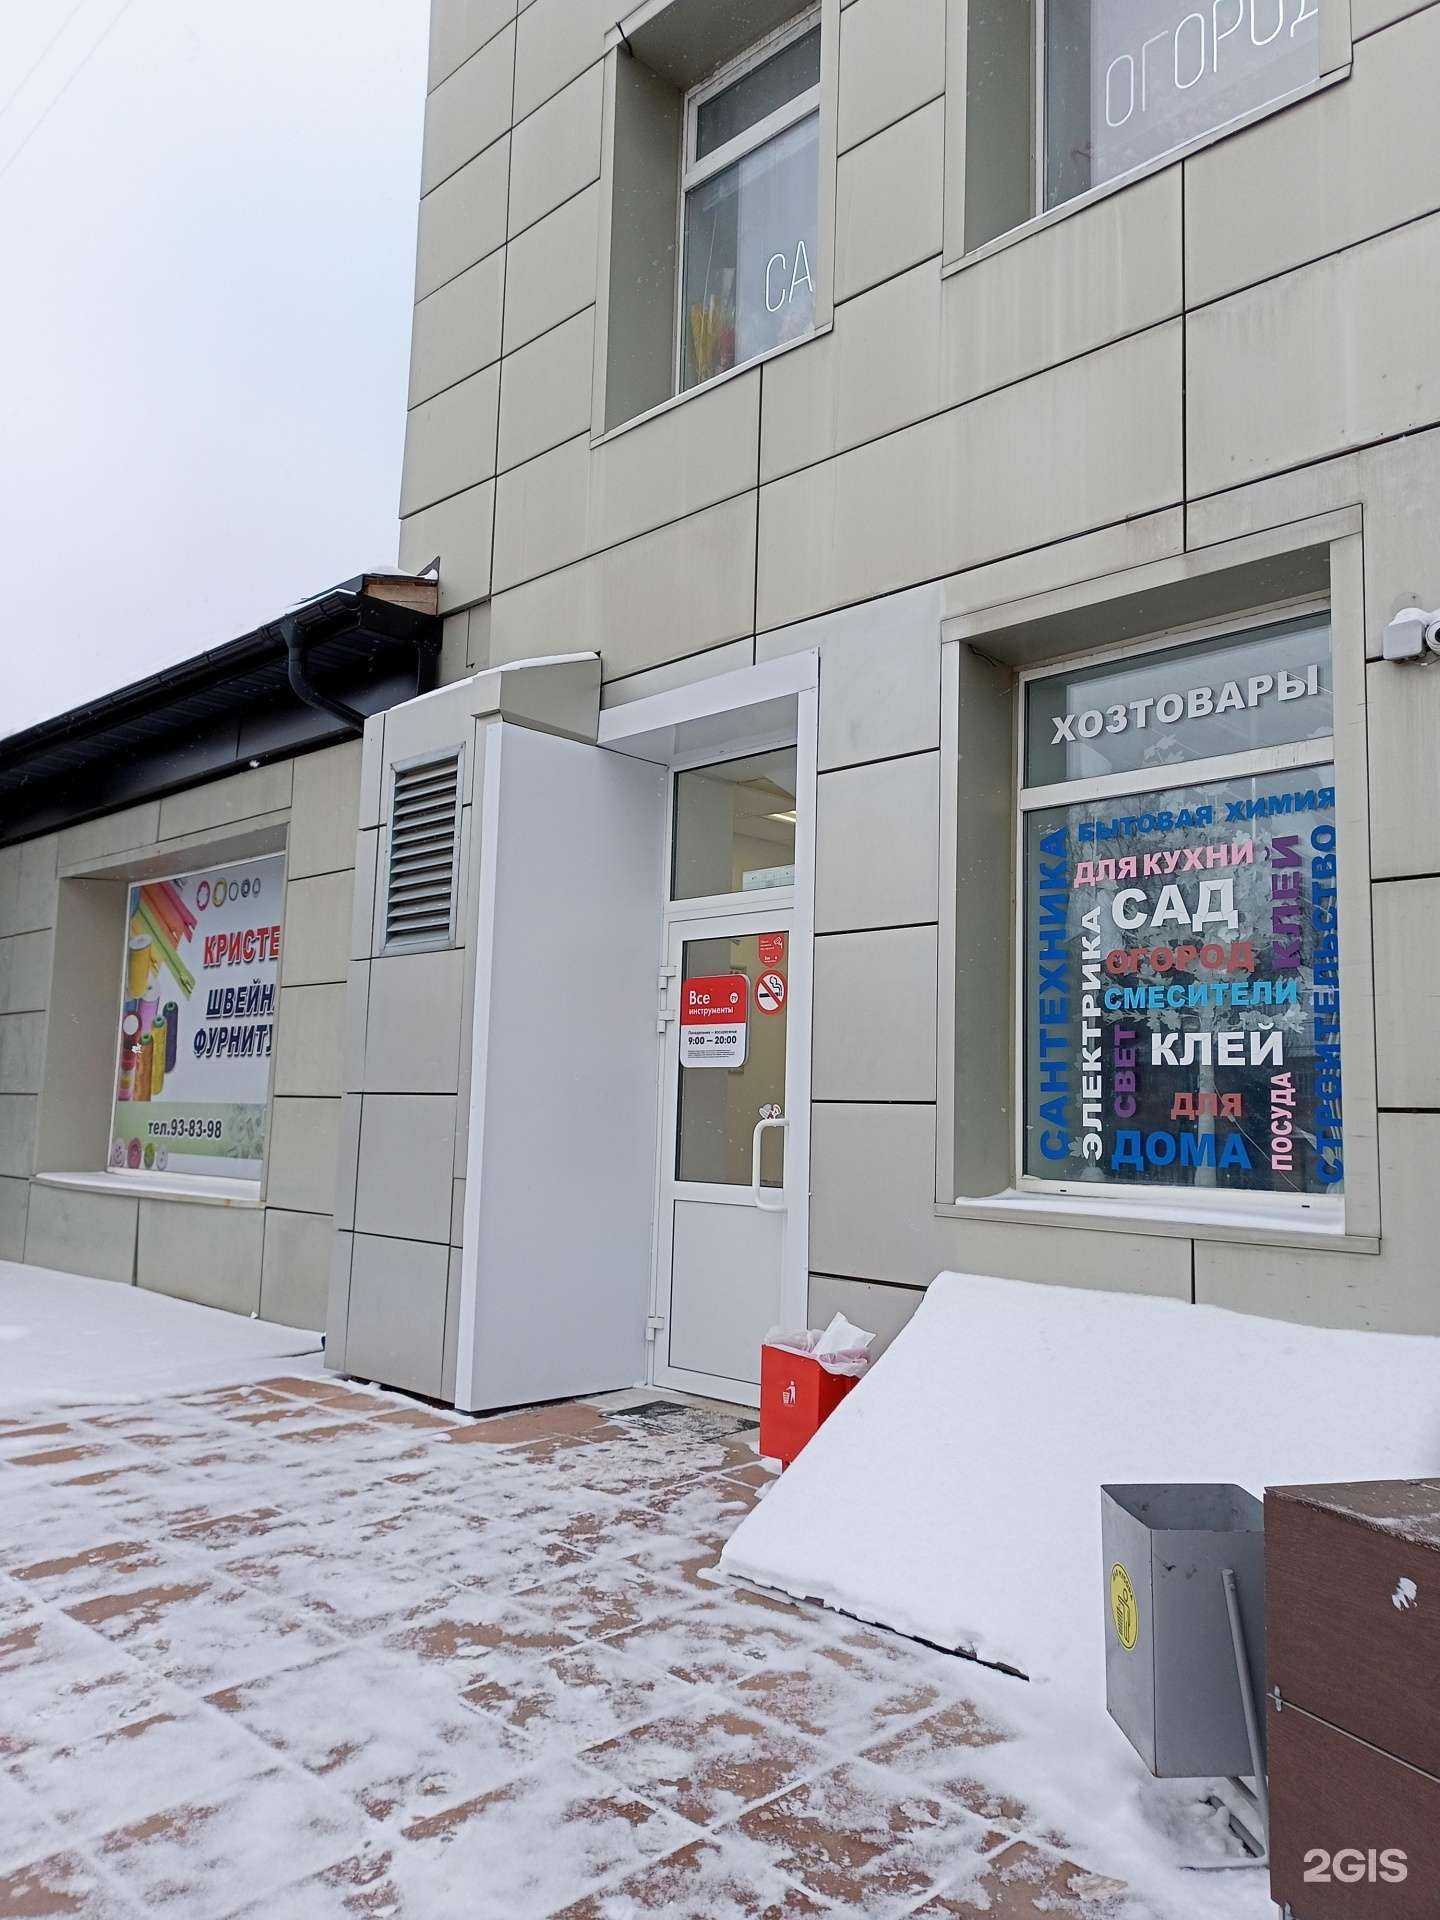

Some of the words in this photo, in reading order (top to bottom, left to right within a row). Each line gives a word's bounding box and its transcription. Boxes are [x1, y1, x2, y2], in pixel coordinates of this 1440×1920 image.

[765, 240, 813, 312] СА
[1050, 664, 1319, 745] ХОЗТОВАРЫ
[1078, 804, 1214, 843] БЫТОВАЯ
[1224, 786, 1336, 822] ХИМИЯ
[1073, 855, 1137, 888] ДЛЯ
[1143, 838, 1254, 877] КУХНИ
[1111, 878, 1239, 932] САД
[1264, 834, 1303, 970] КЛЕЙ
[203, 925, 280, 968] КРИСТЕ
[1106, 941, 1255, 975] ОГОРОД
[205, 978, 275, 1019] ШВЕЙН
[688, 1007, 734, 1017] инструменты
[689, 990, 711, 1006] Все
[1039, 826, 1070, 1161] САНТЕХНИКА
[1104, 981, 1298, 1010] СМЕСИТЕЛИ
[1311, 824, 1345, 1184] СТРОИТЕЛЬСТВО
[688, 1036, 705, 1045] 9:00
[714, 1035, 737, 1045] 20:00
[1081, 906, 1103, 1160] ЭЛЕКТРИКА
[1150, 1022, 1285, 1066] КЛЕЙ
[1113, 1025, 1137, 1119] СВЕТ
[1170, 1092, 1244, 1121] ДЛЯ
[1271, 1071, 1296, 1171] ПОСУДА
[1111, 1129, 1253, 1173] ДОМА
